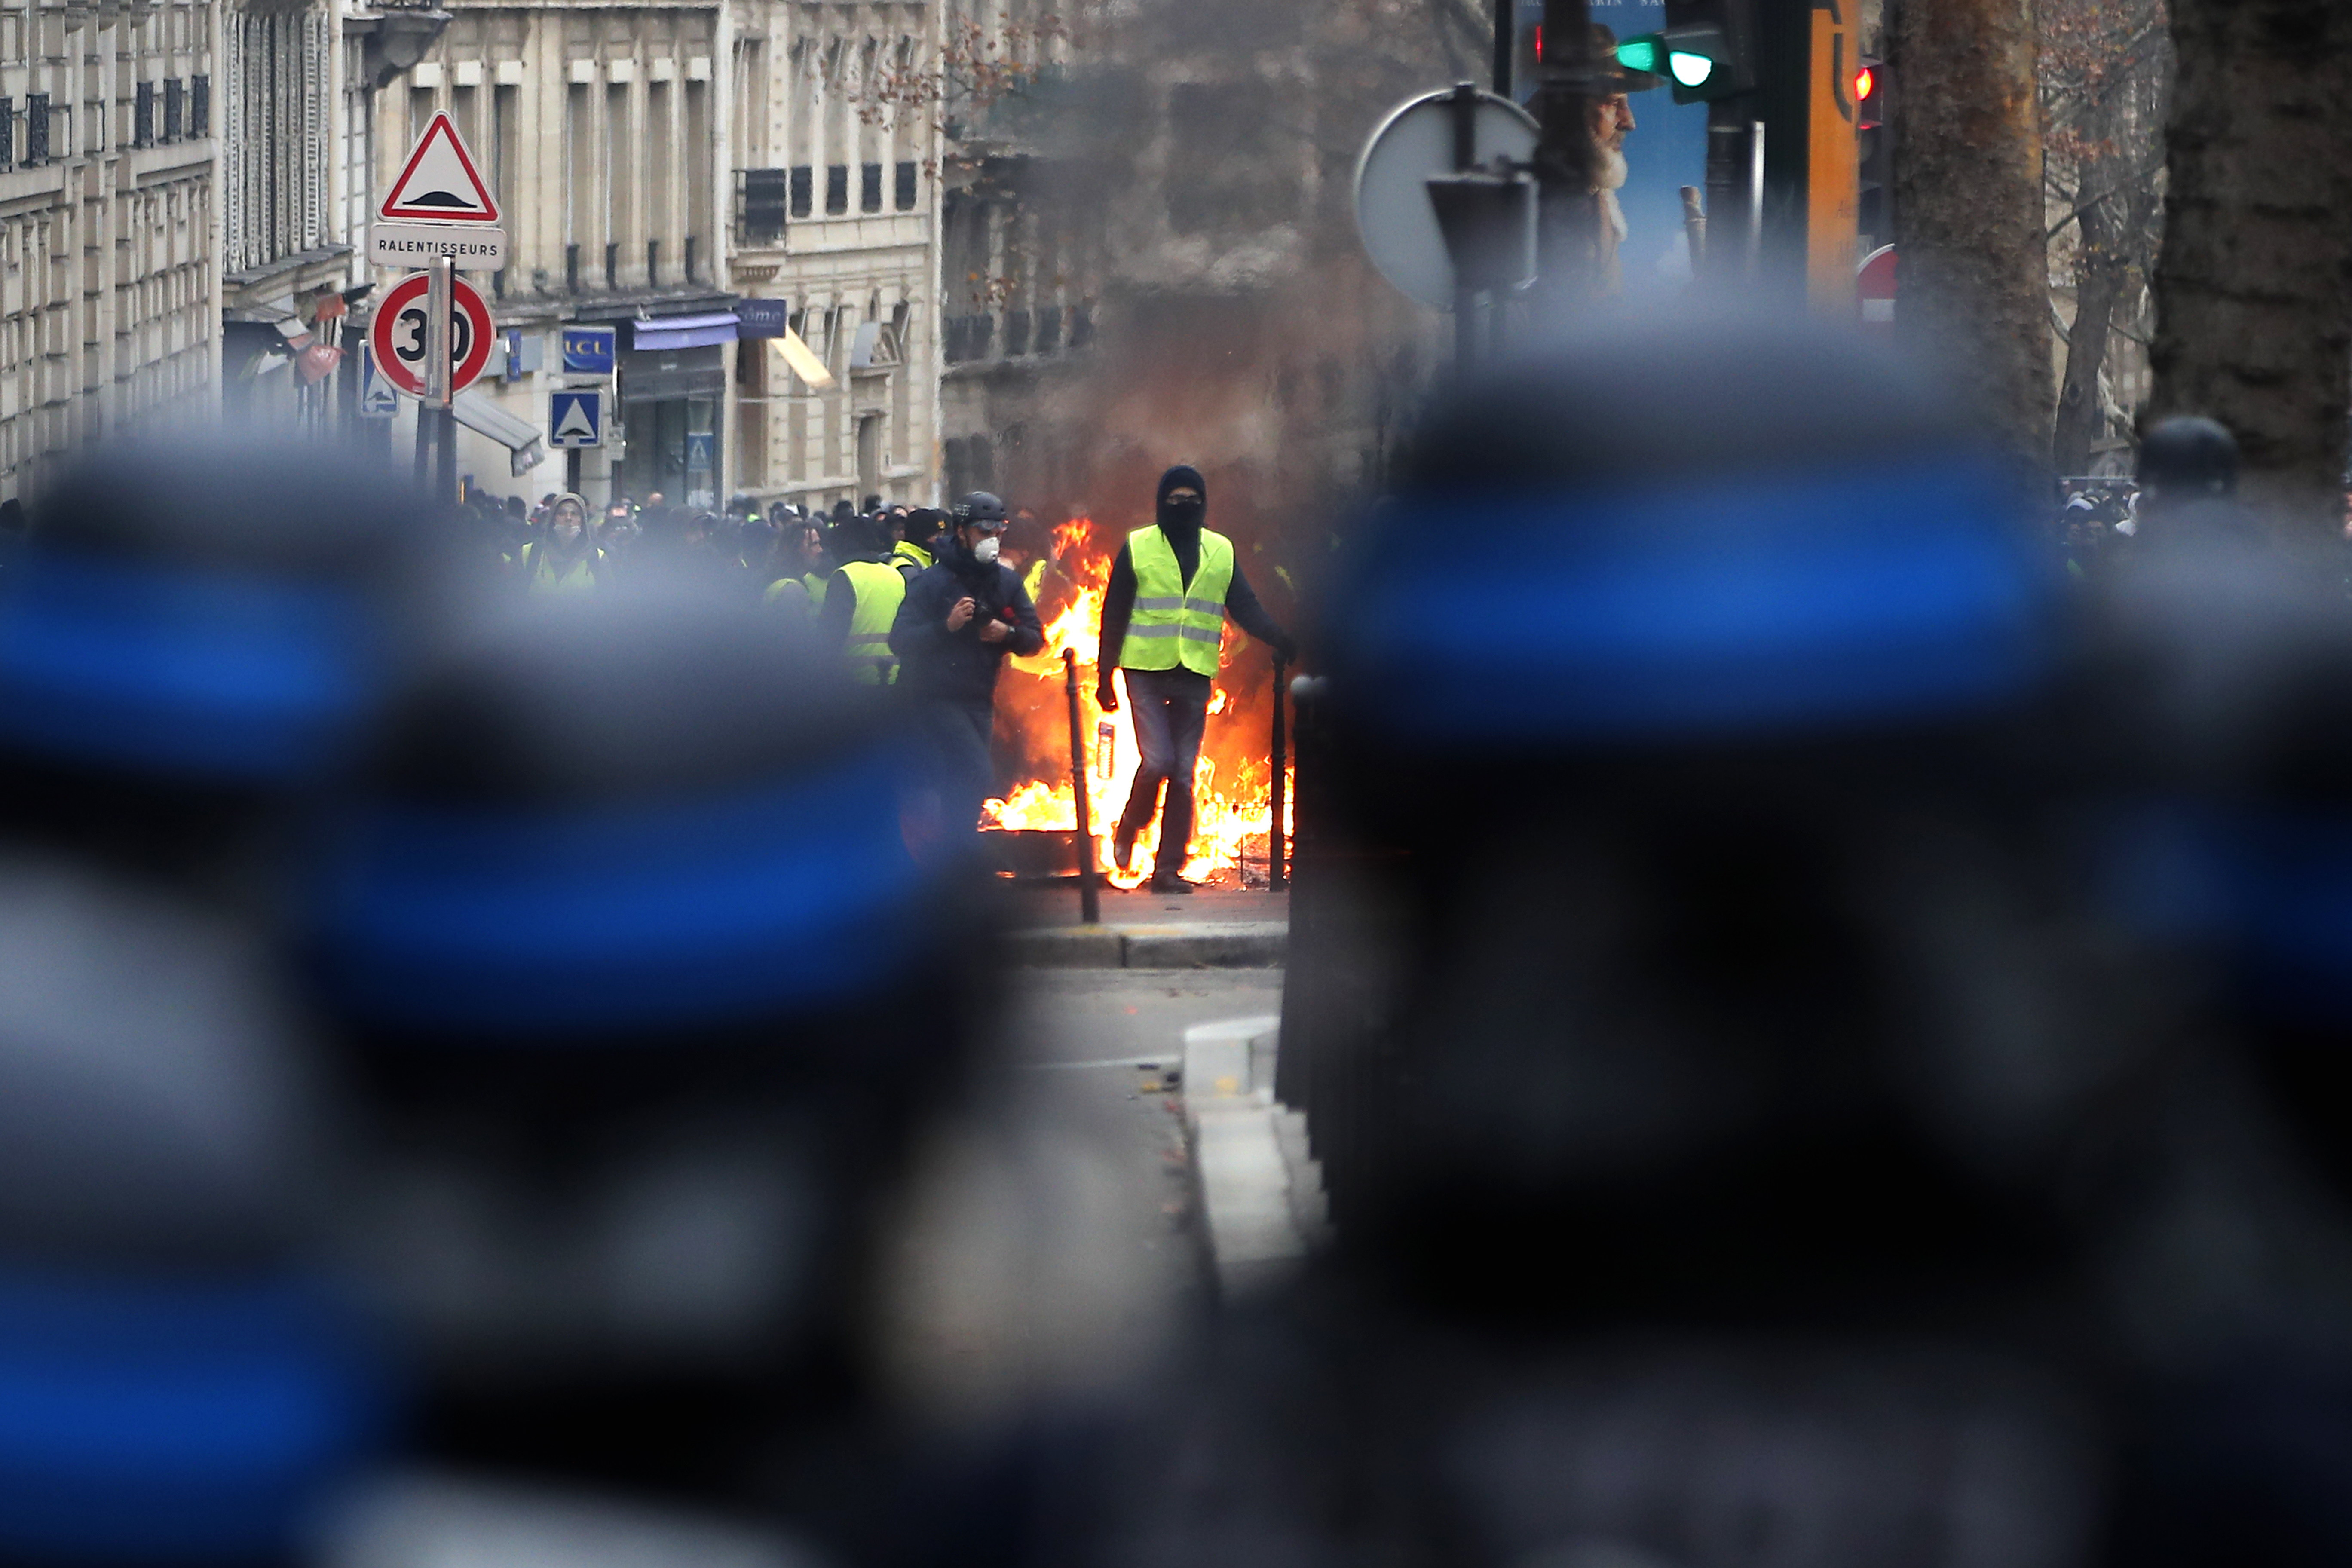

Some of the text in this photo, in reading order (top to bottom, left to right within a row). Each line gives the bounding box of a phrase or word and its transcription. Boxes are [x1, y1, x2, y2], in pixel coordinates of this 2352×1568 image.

[379, 239, 497, 256] RALENTISSEURS
[396, 308, 469, 361] 30
[565, 341, 607, 355] LCL
